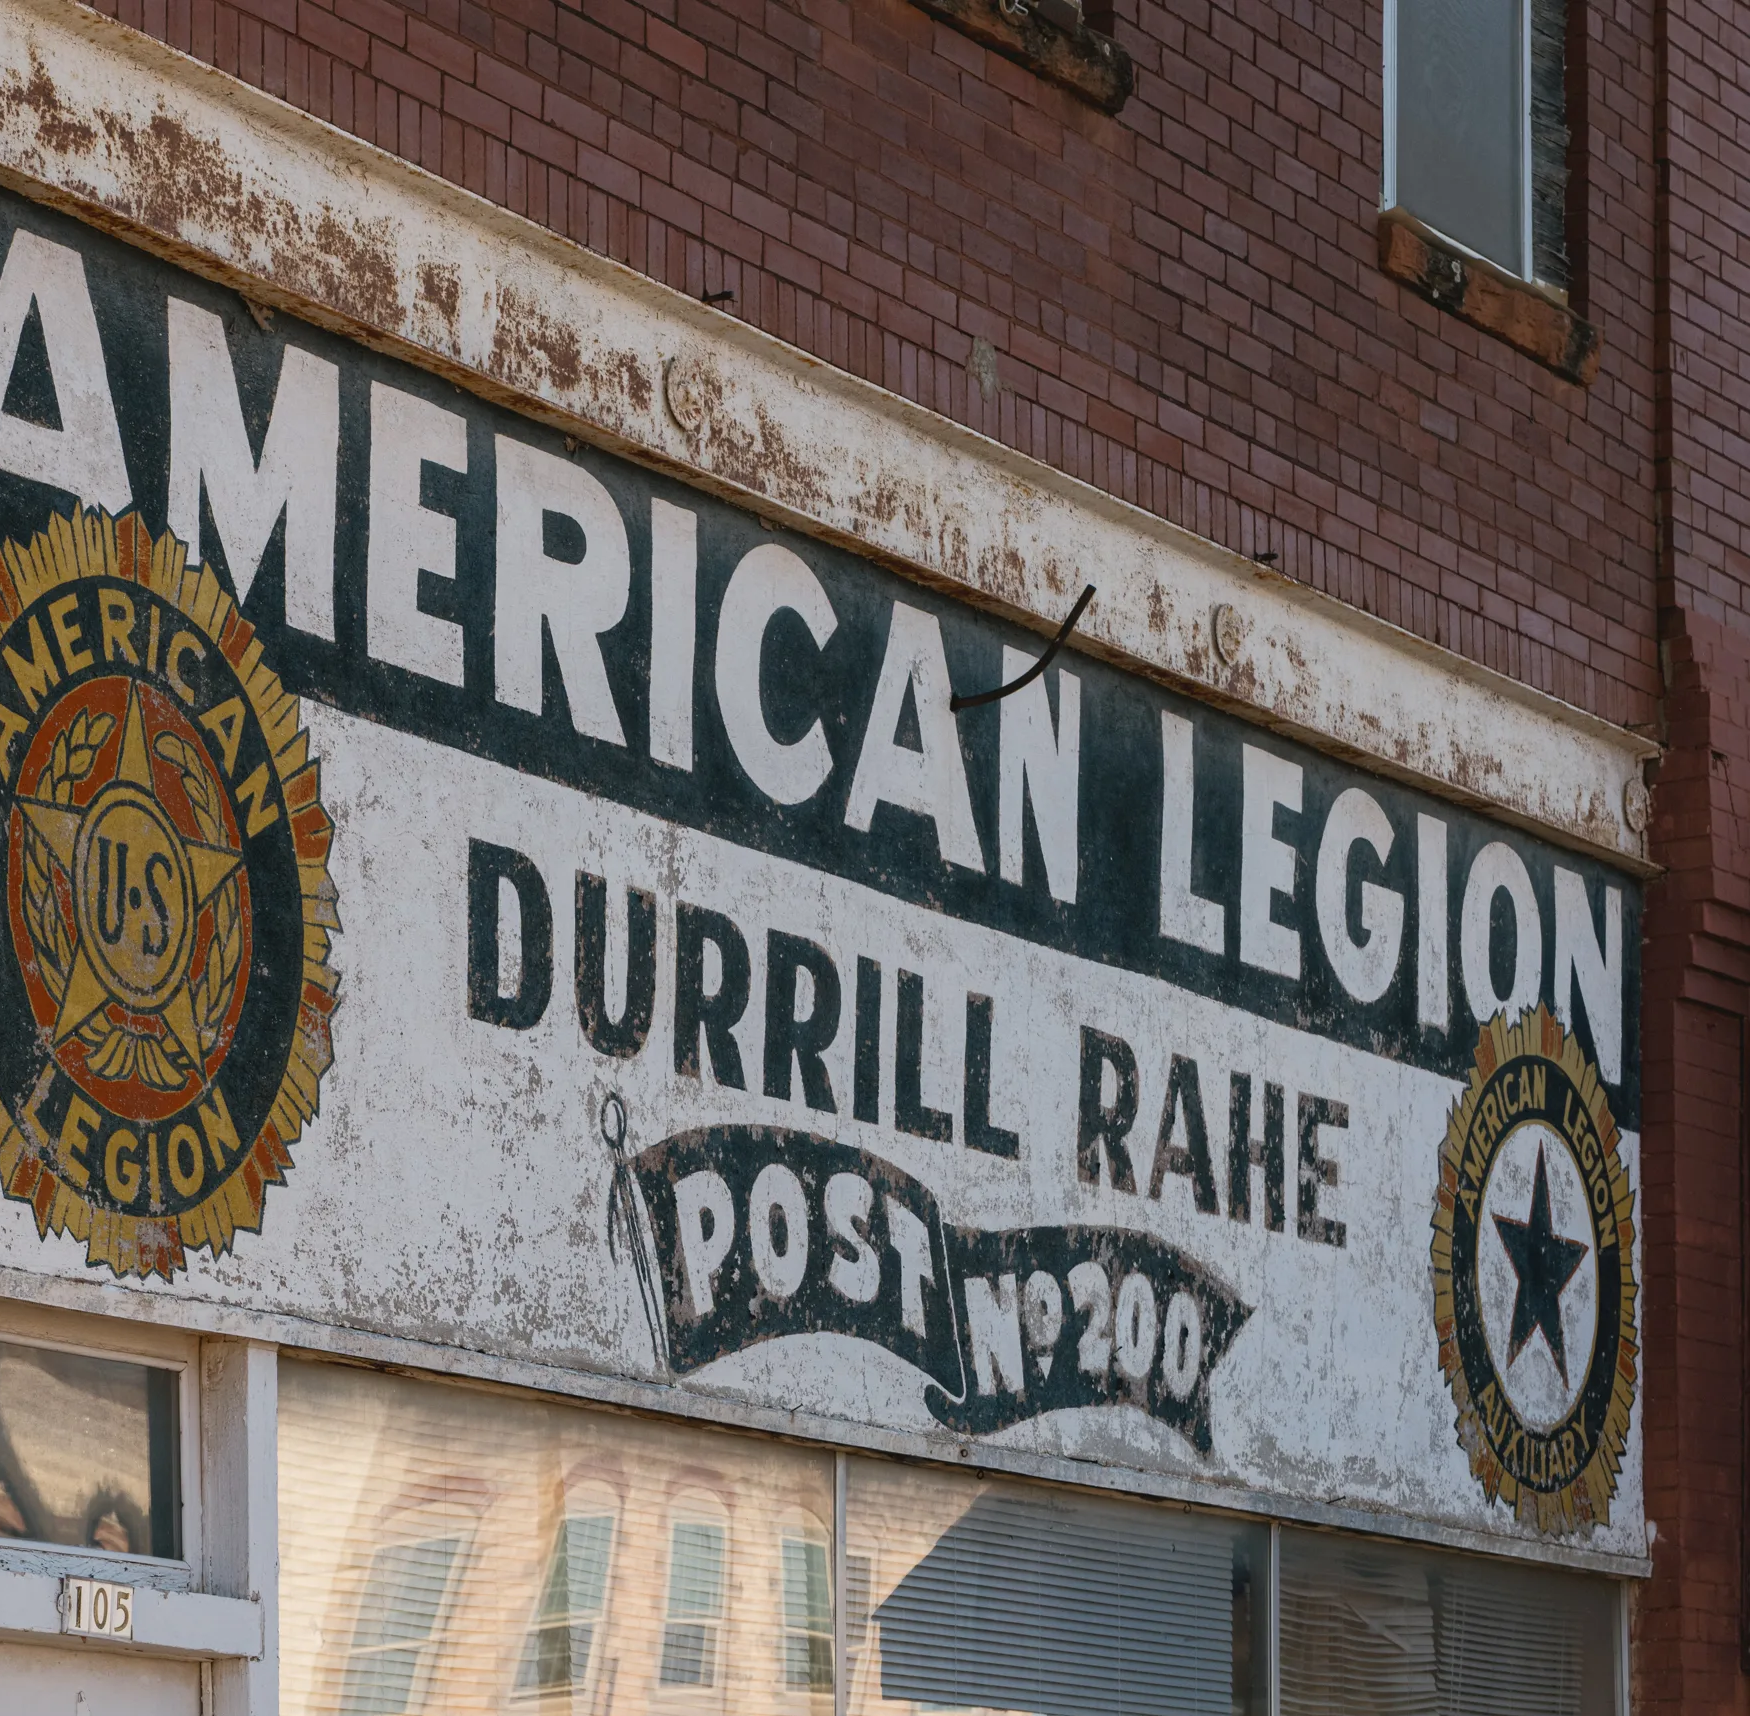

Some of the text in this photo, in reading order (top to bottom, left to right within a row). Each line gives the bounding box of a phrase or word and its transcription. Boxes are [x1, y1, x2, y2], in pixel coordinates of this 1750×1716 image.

[1159, 709, 1622, 1086] LEGION
[467, 836, 1349, 1249] DURRILL RAHE
[25, 1064, 242, 1204] LEGION
[1461, 1065, 1616, 1248] AMERICAN LEGION
[673, 1163, 934, 1338] POST
[1478, 1381, 1591, 1488] AUXILIARY
[74, 1583, 131, 1634] 105
